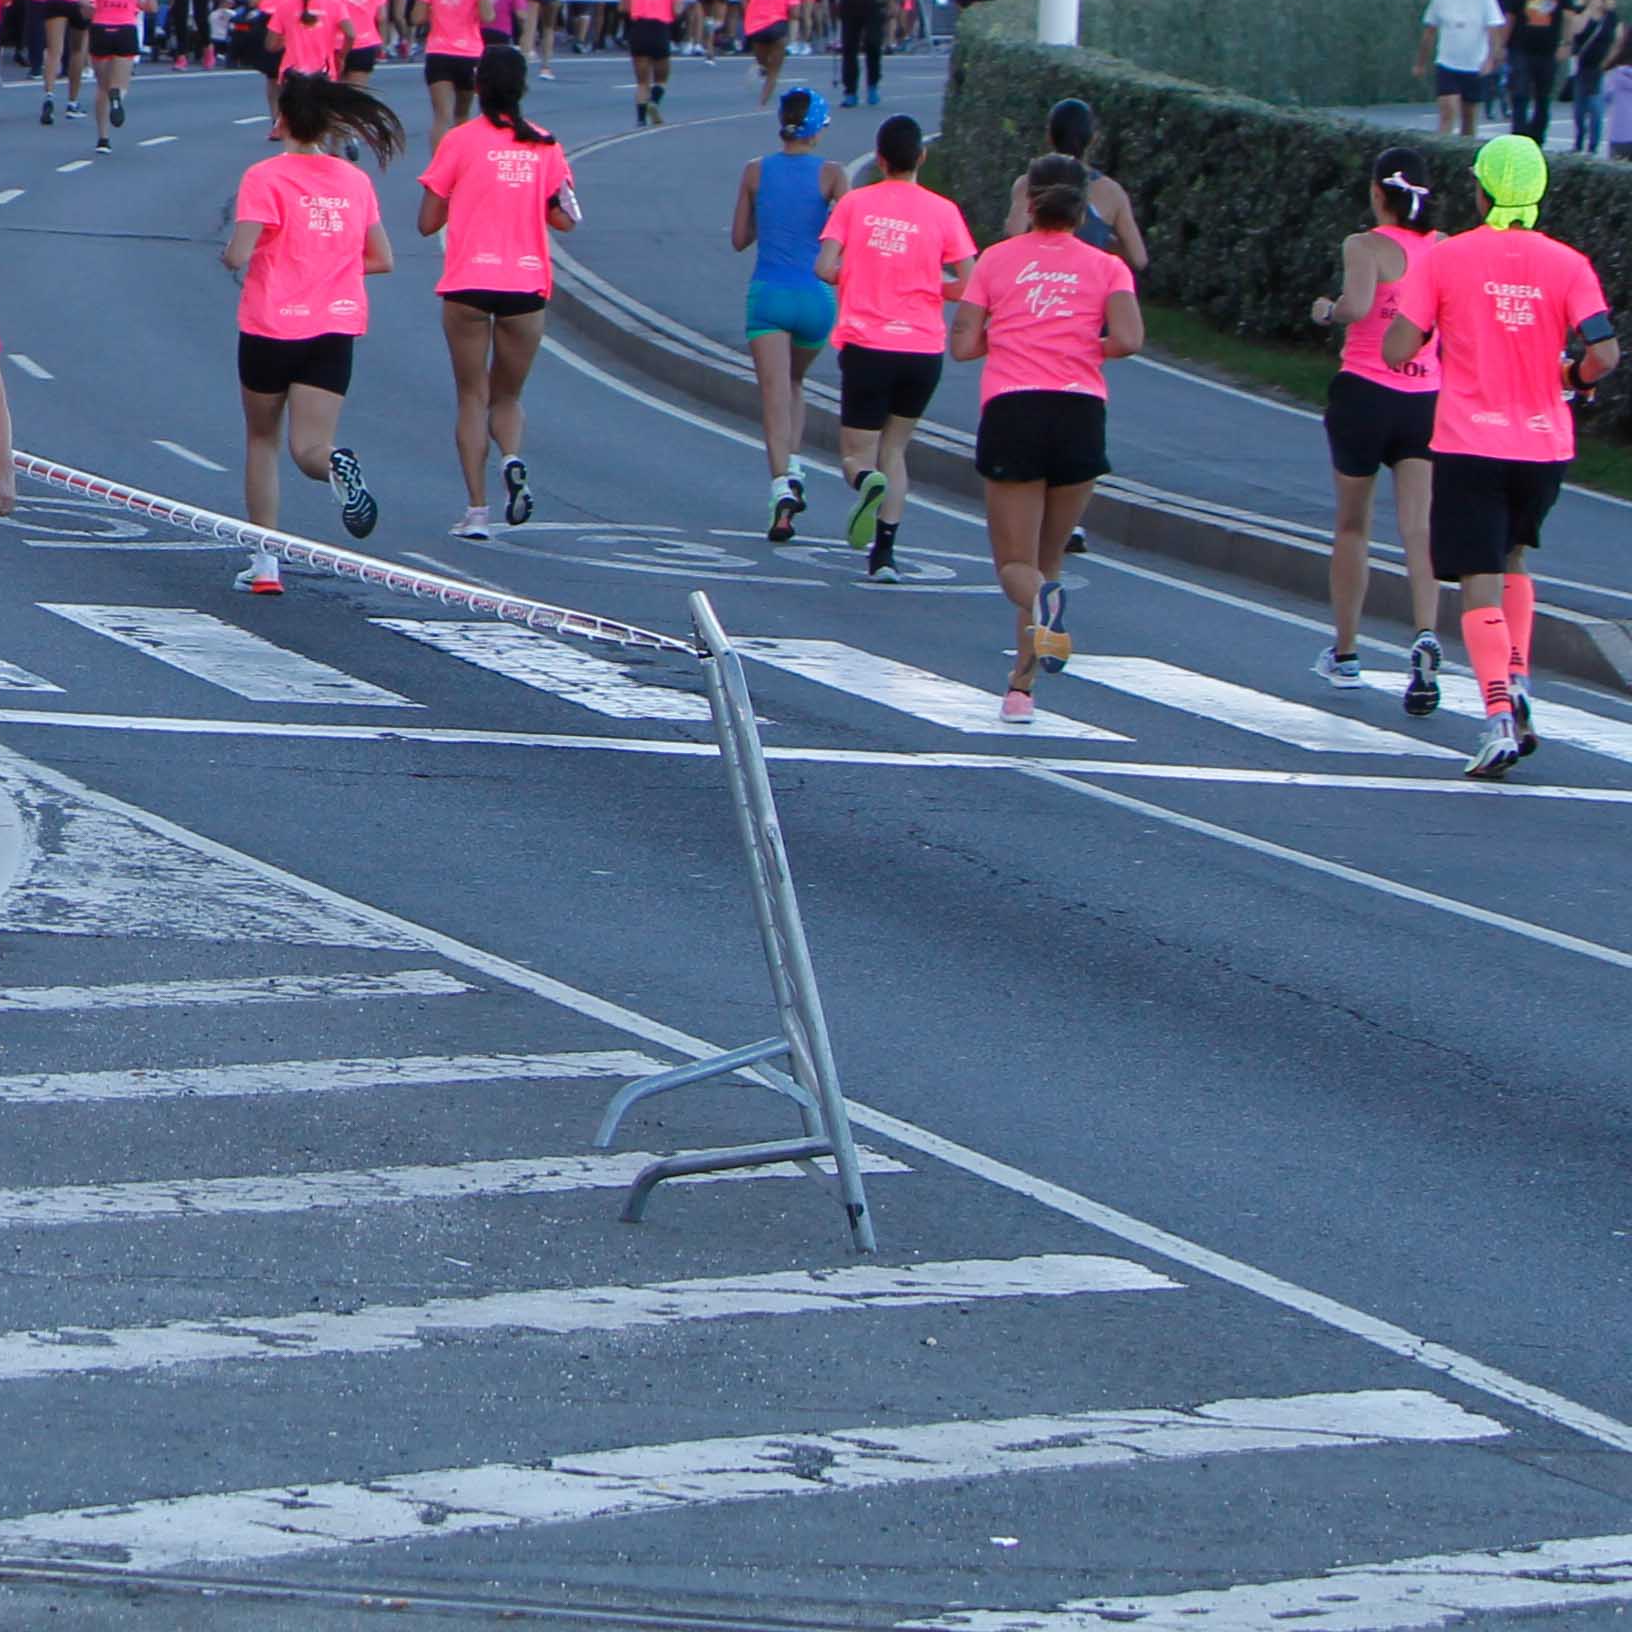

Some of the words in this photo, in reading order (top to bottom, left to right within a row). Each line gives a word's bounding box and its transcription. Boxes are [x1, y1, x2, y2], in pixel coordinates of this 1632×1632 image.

[488, 150, 540, 163] CARRERA
[498, 161, 513, 172] DE
[516, 162, 531, 172] LA
[497, 172, 534, 183] MUJER
[863, 215, 920, 235] CARRERA
[872, 228, 888, 240] DE
[891, 231, 907, 242] LA
[867, 239, 908, 254] MUJER
[1484, 281, 1544, 300] CARRERA
[1496, 297, 1513, 311] DE
[1514, 299, 1532, 312] LA
[1496, 311, 1536, 325] MUJER
